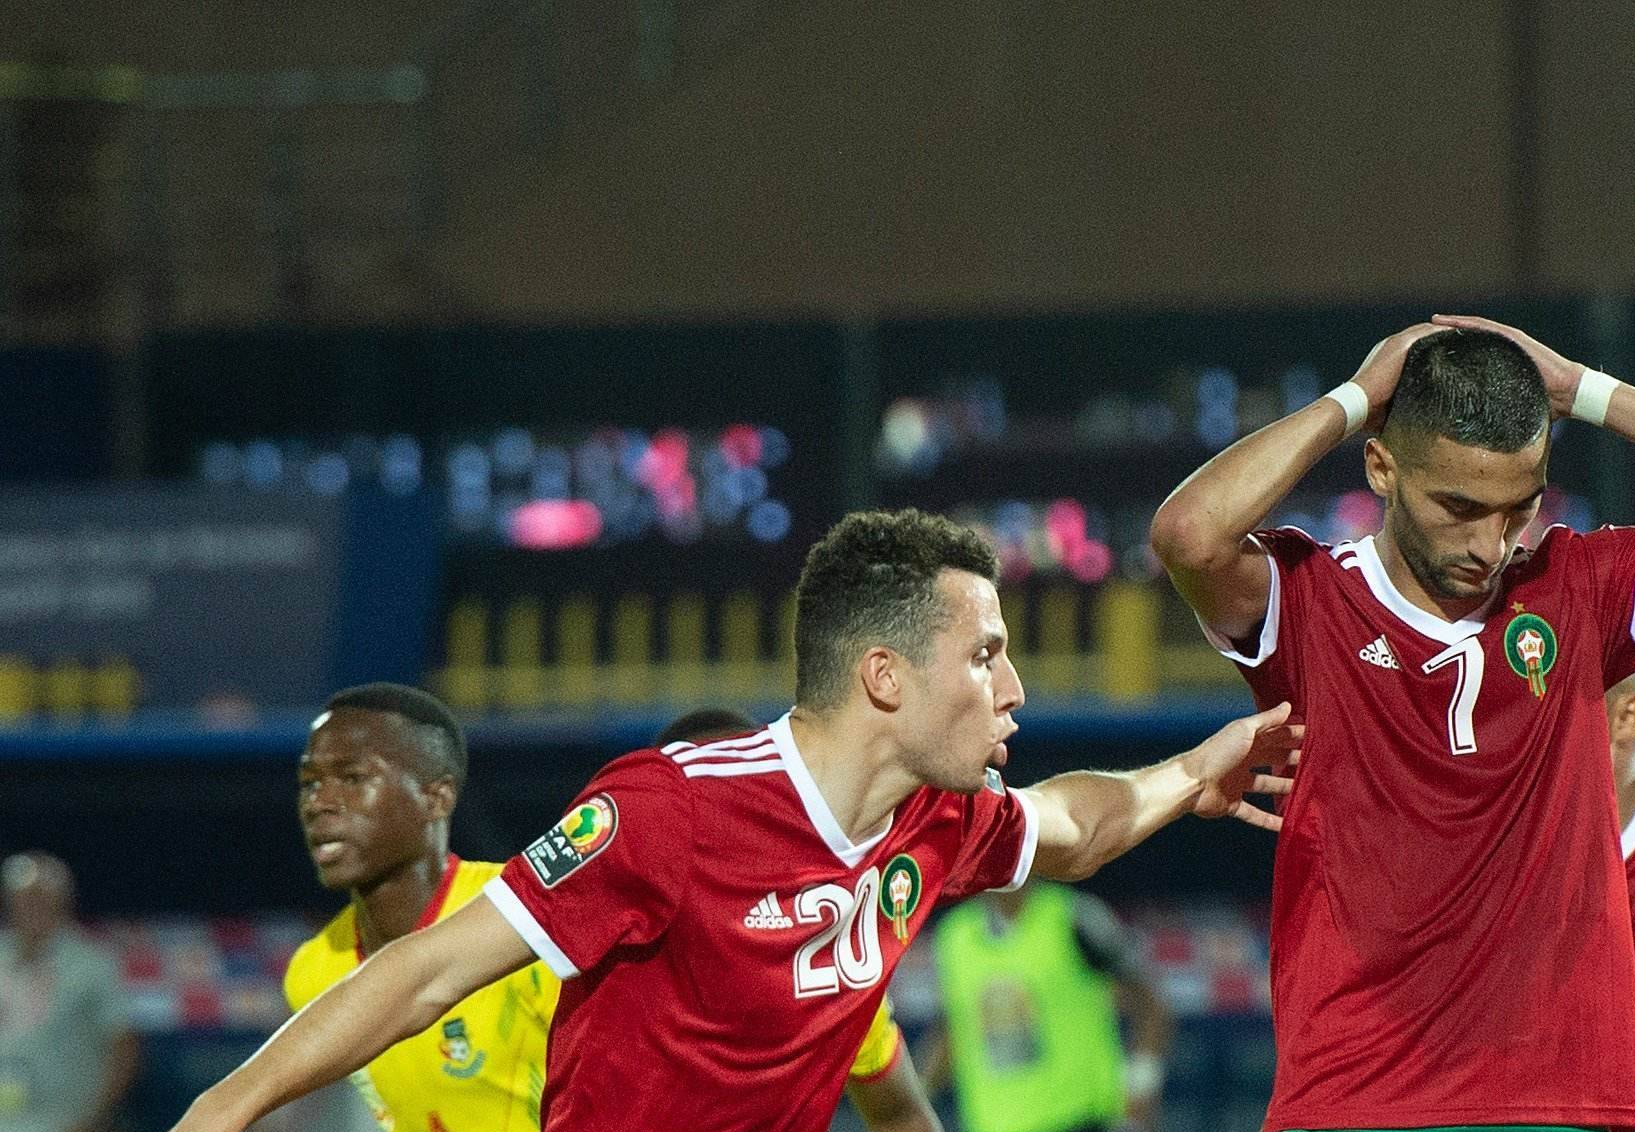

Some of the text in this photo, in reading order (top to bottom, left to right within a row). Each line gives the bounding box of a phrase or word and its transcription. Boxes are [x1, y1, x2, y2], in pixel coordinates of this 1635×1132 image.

[1359, 648, 1400, 669] adida
[1422, 636, 1485, 756] 7
[744, 916, 794, 929] adidas
[793, 866, 884, 999] 20
